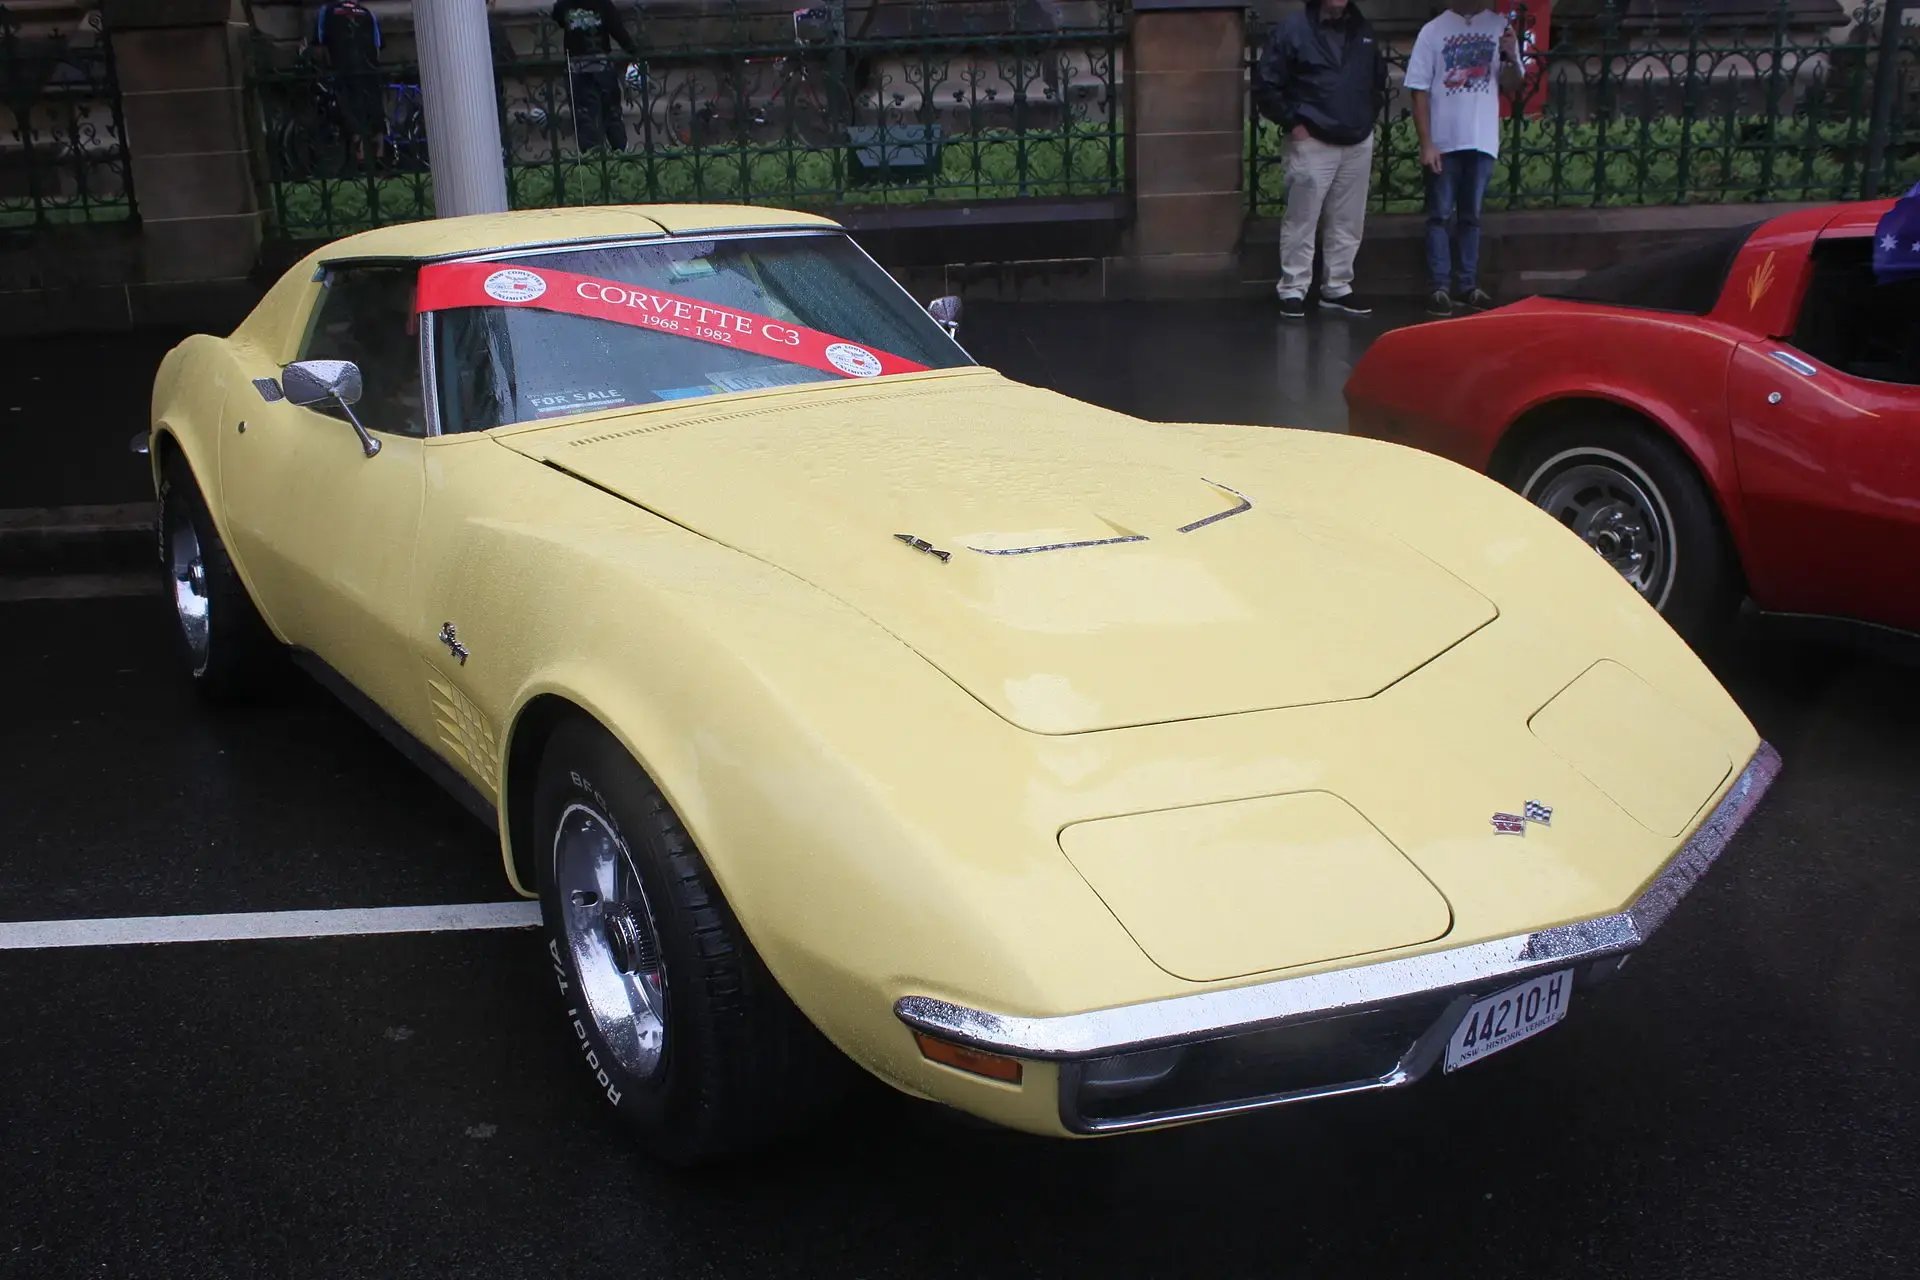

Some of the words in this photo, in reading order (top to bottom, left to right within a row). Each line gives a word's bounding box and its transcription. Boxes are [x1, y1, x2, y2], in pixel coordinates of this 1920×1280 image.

[576, 282, 752, 334] CORVETTE
[761, 324, 800, 345] C3
[642, 314, 678, 330] 1968
[696, 326, 732, 343] 1982
[531, 395, 568, 407] FOR
[573, 389, 621, 401] SALE
[549, 938, 569, 996] T/A
[568, 1008, 622, 1107] Radial
[1460, 1047, 1479, 1061] NSW
[1485, 1029, 1523, 1051] HISTORIC
[1525, 1013, 1557, 1033] VEHICLE
